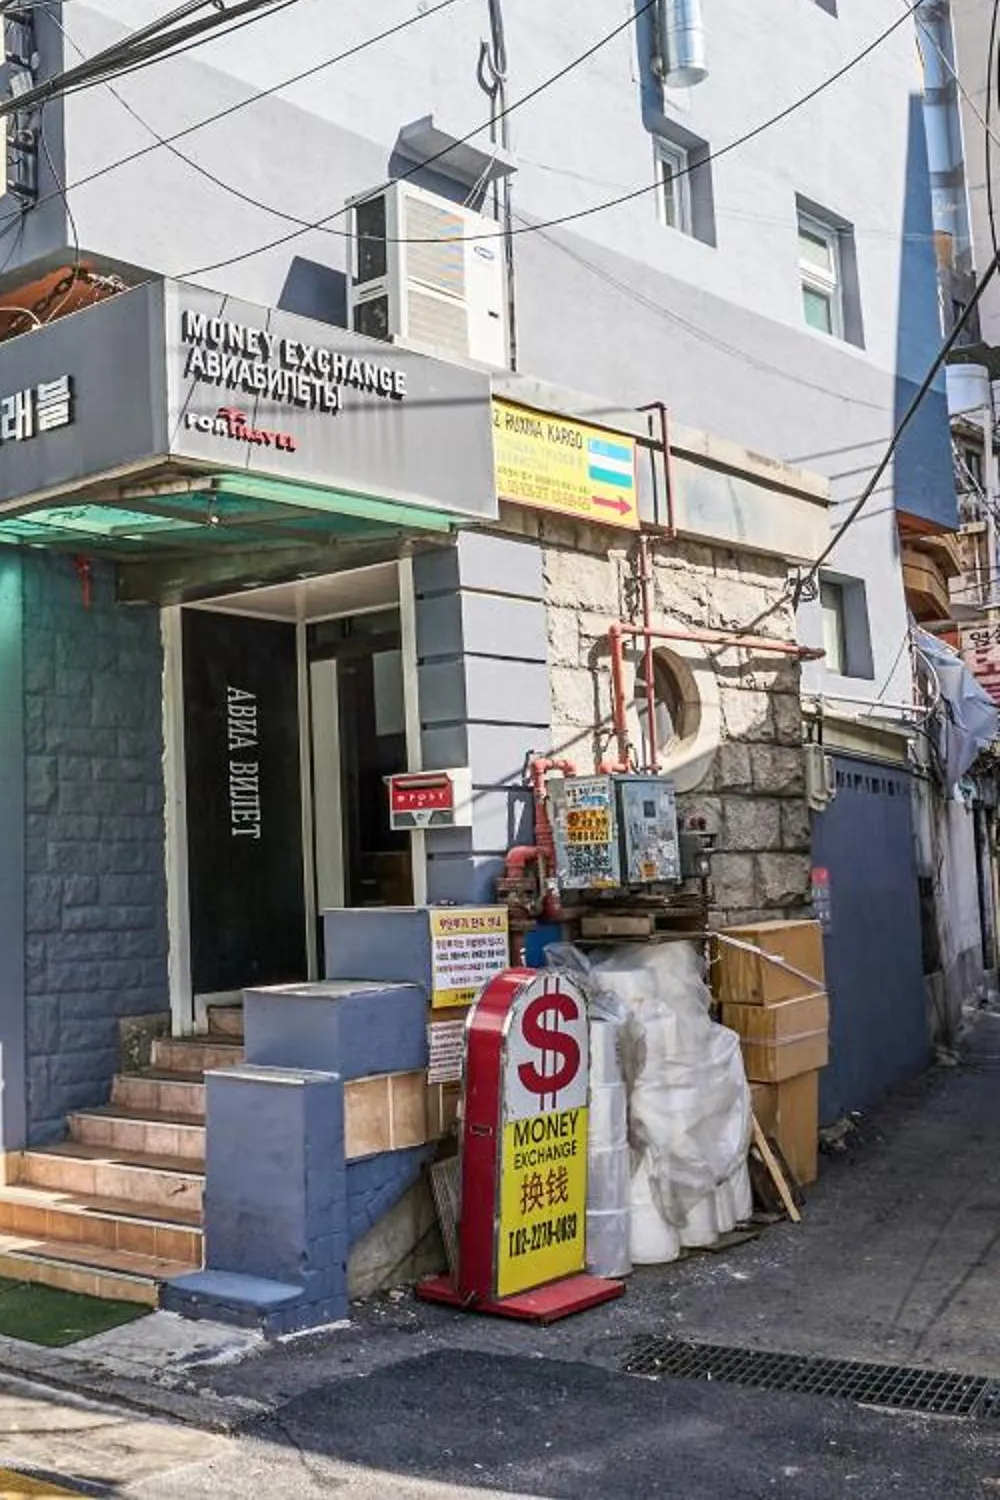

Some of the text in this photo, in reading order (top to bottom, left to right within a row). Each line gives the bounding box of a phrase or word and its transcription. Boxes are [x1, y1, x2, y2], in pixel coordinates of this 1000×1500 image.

[182, 310, 408, 399] MONEY EXCHANGE
[184, 346, 342, 410] АВИАБИЛЕТЫ
[547, 423, 583, 449] KARGO
[227, 686, 258, 751] АВИА
[517, 976, 581, 1110] $
[513, 1111, 579, 1148] MONEY
[513, 1140, 577, 1171] EXCHANGE
[519, 1165, 569, 1216] 换钱
